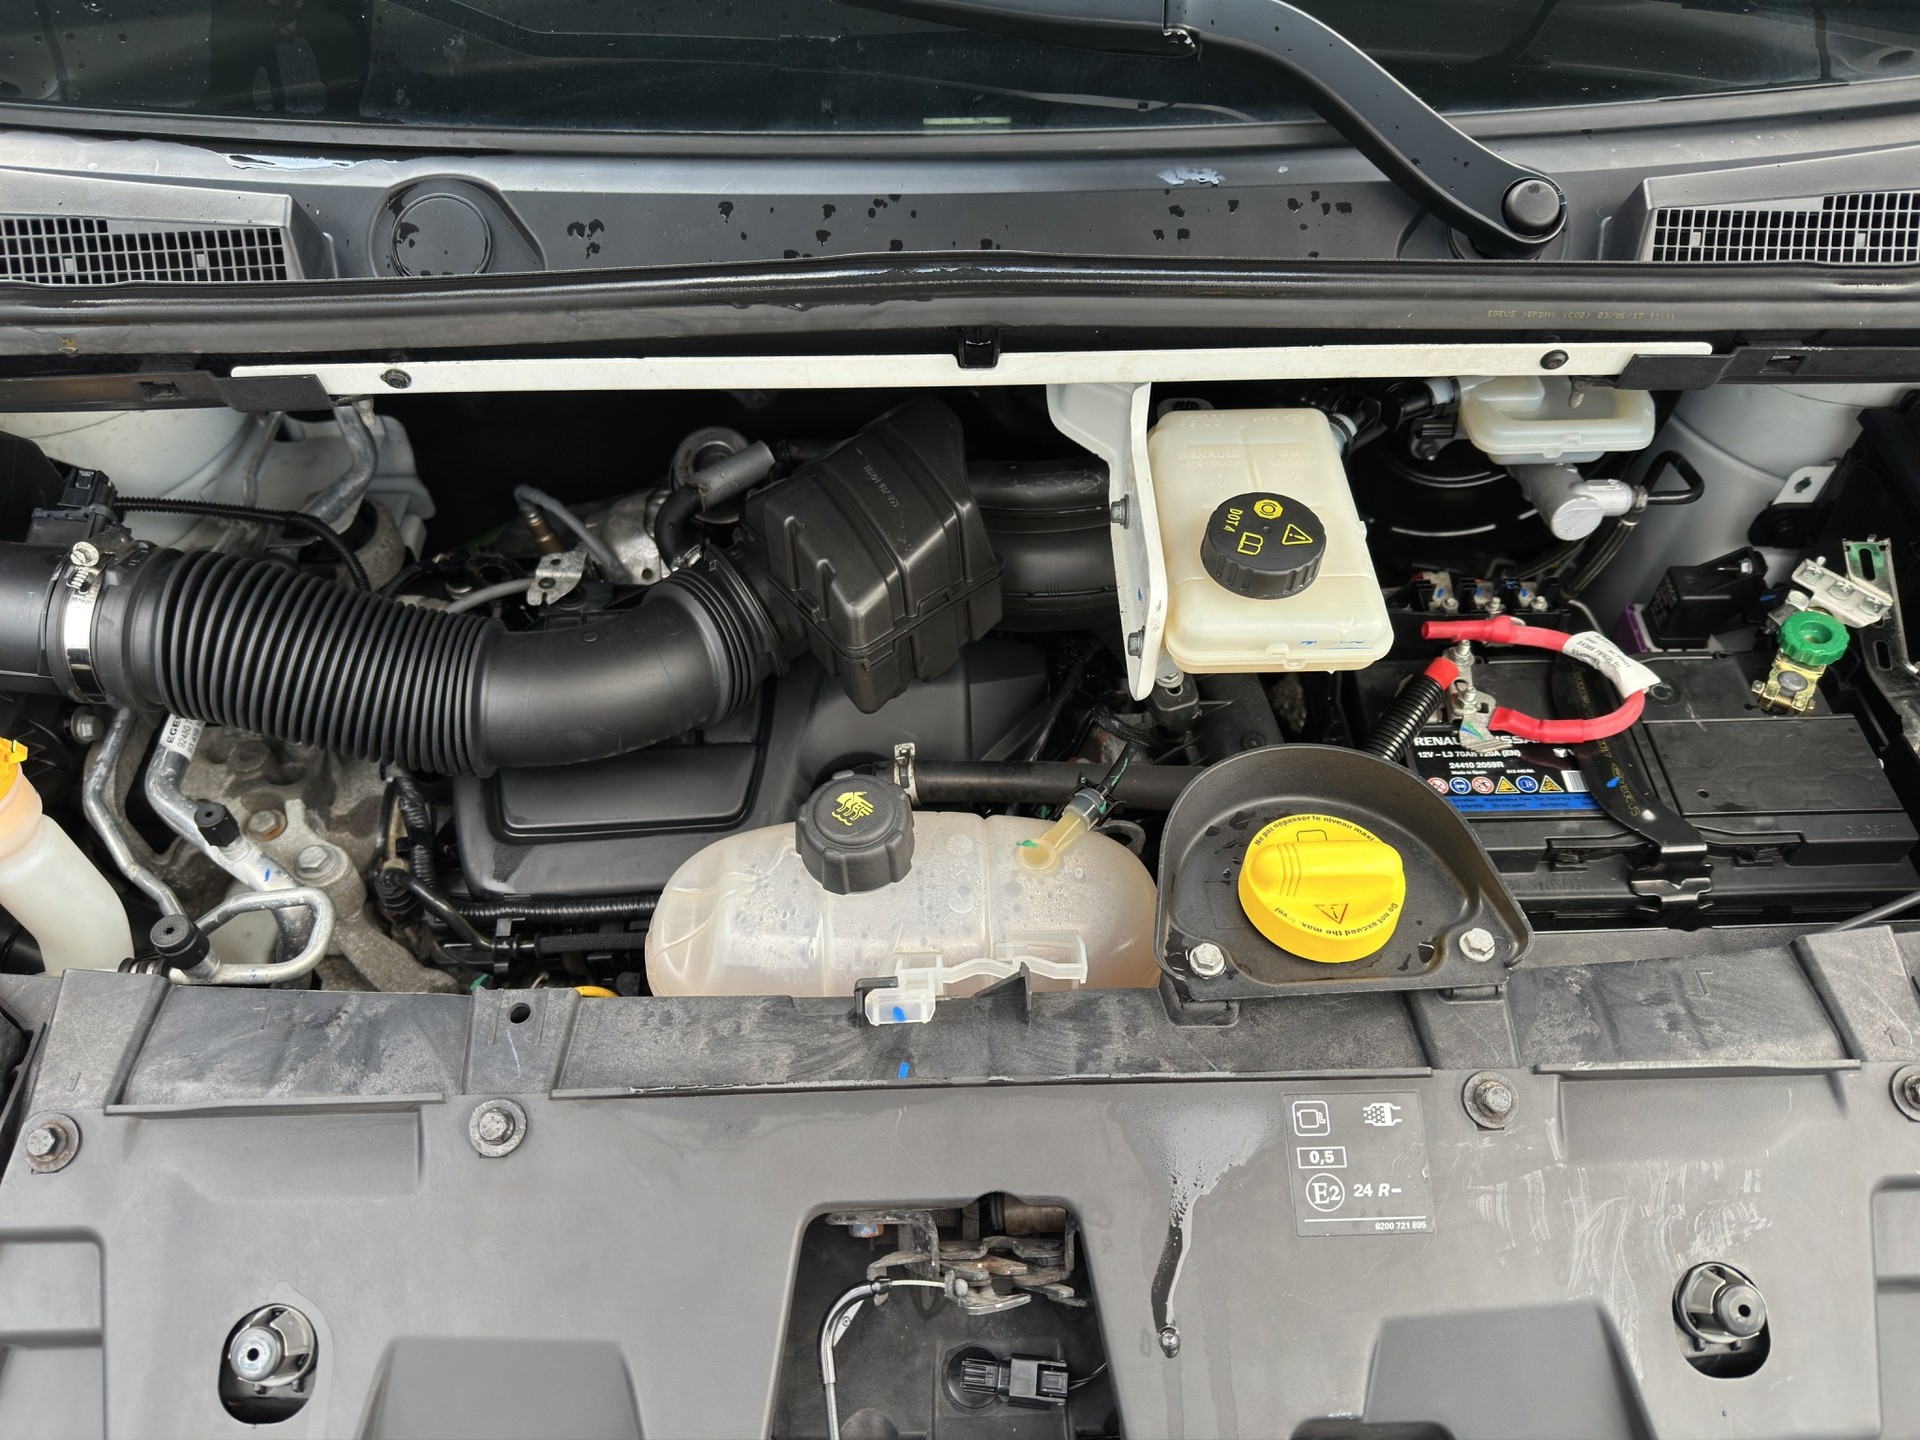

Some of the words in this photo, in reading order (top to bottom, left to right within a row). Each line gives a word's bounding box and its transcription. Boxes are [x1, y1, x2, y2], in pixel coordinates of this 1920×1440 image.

[1488, 310, 1516, 318] EGEUS
[1225, 508, 1244, 527] DOT
[1223, 524, 1236, 533] 4
[166, 716, 180, 743] EGE
[177, 725, 191, 748] 92480
[1417, 751, 1434, 759] 12V
[1502, 750, 1521, 758] (EN)
[1254, 836, 1263, 846] Ne
[1263, 827, 1274, 837] pas
[1273, 815, 1311, 828] dépasser
[1324, 817, 1353, 829] niveau
[1354, 826, 1375, 842] maxi
[1389, 902, 1399, 913] Do
[1378, 912, 1390, 924] not
[1309, 1150, 1335, 1165] 0,5
[1312, 1182, 1341, 1204] E2
[1353, 1183, 1373, 1197] 24
[1375, 1222, 1394, 1230] 8200
[1396, 1222, 1410, 1230] 721
[1412, 1221, 1427, 1229] 895
